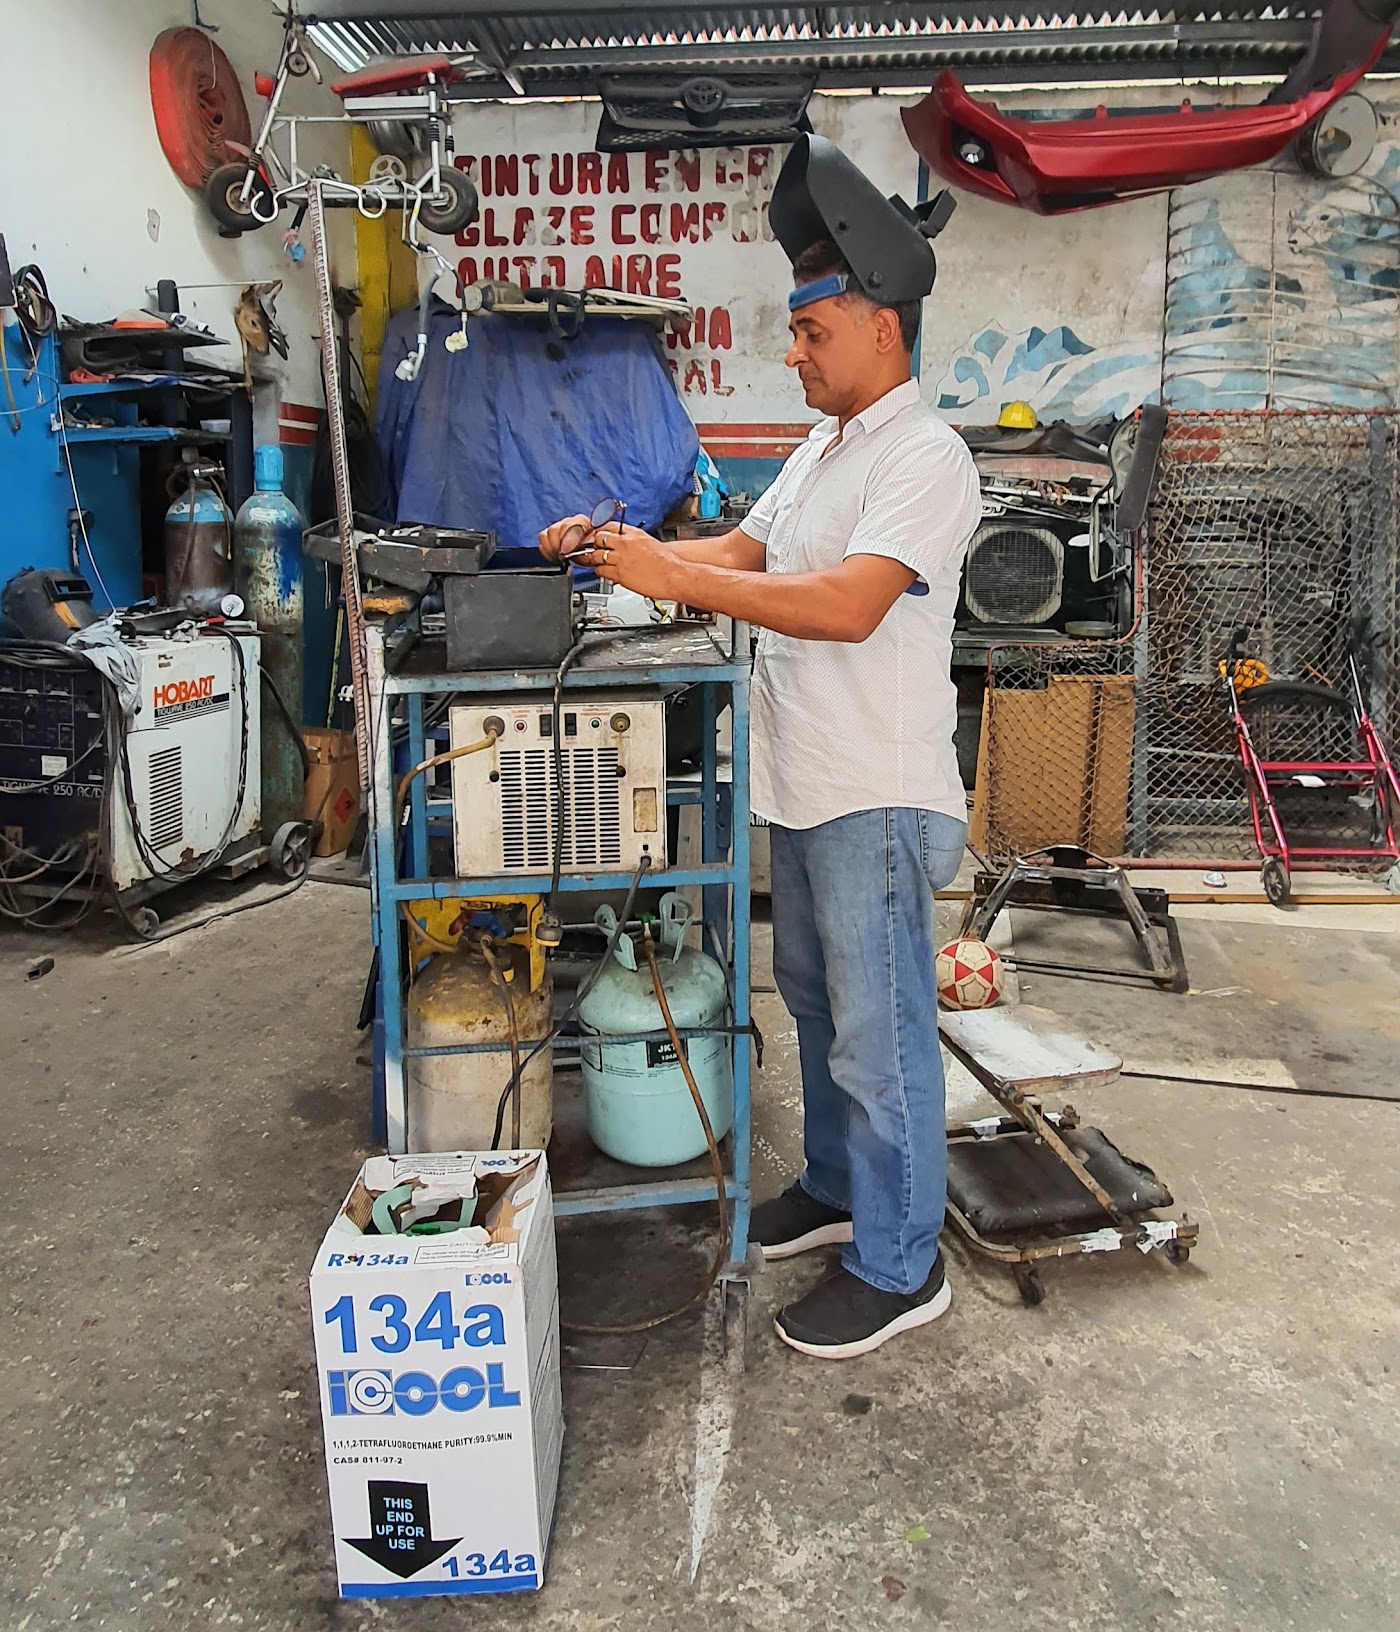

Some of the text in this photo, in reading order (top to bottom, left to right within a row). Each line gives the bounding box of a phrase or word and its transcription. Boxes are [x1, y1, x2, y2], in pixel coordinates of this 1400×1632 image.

[584, 254, 682, 298] AIRE
[154, 675, 215, 708] HOBART
[53, 784, 73, 796] 250
[327, 1253, 409, 1267] R-134a
[324, 1290, 506, 1354] 134a
[332, 1439, 443, 1450] 1,1,1,2-TETRAFLUOROETHANE
[333, 1456, 359, 1464] CAS#
[383, 1497, 413, 1510] THIS
[386, 1511, 414, 1523] END
[375, 1524, 425, 1537] UP FOR
[388, 1538, 416, 1550] USE
[442, 1549, 536, 1578] 134a
